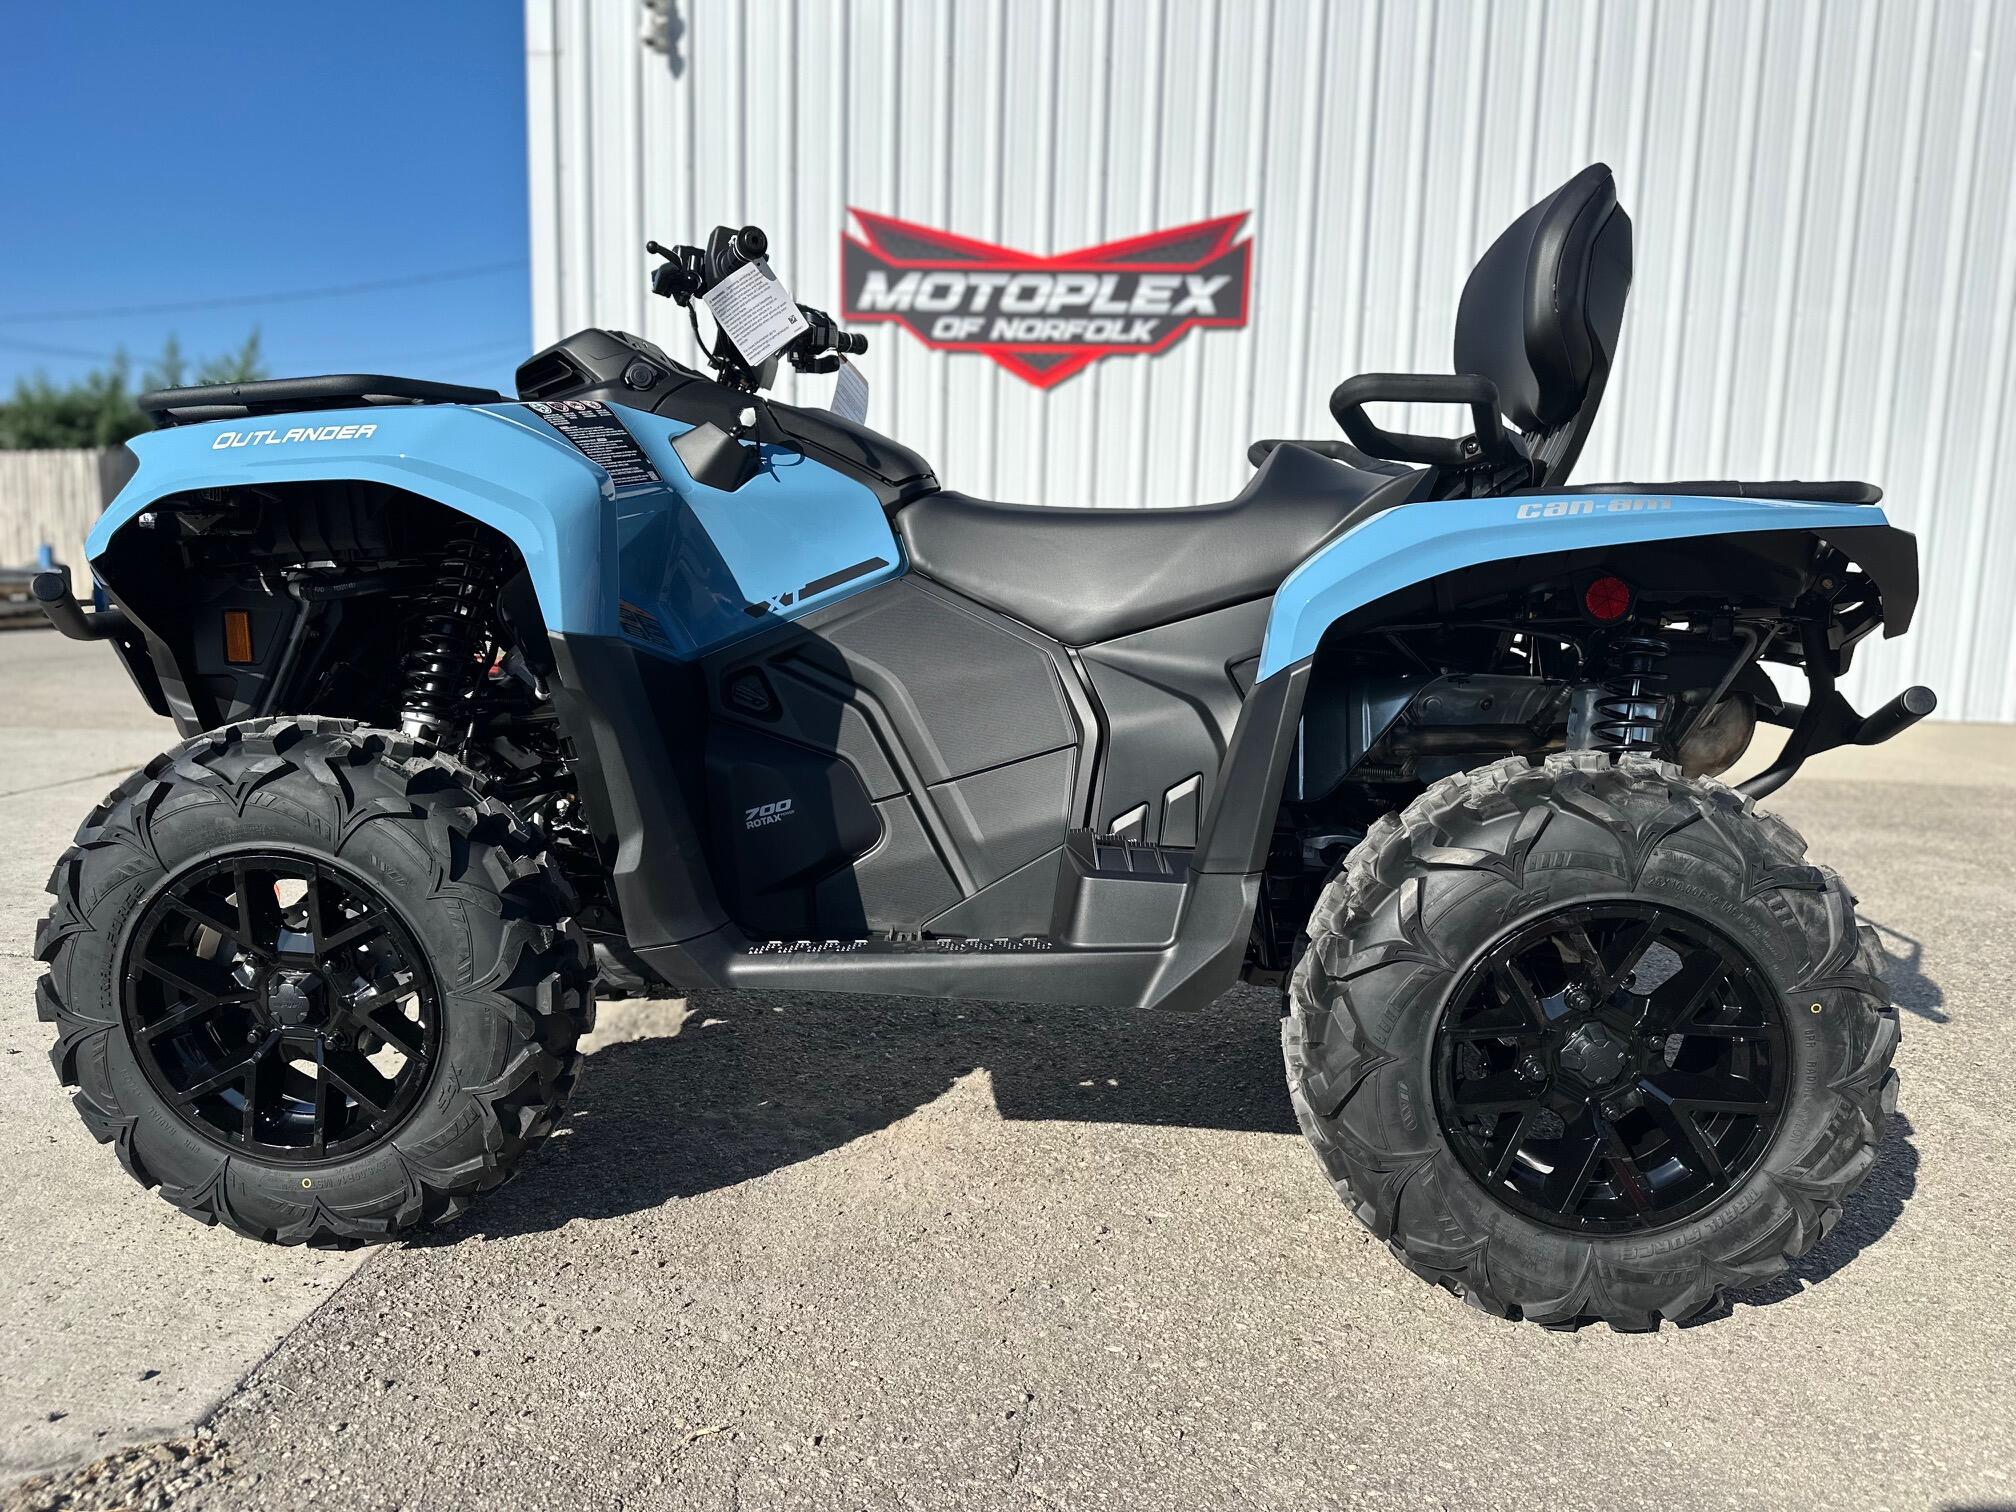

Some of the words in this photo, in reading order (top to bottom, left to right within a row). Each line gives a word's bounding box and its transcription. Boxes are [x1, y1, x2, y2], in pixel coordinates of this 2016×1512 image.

[857, 270, 1231, 315] MOTOPLEX
[931, 316, 985, 341] OF
[992, 317, 1160, 342] NORFOLK
[212, 424, 378, 450] OUTLANDER
[1516, 498, 1673, 520] can-am
[765, 584, 807, 612] XT
[745, 798, 792, 821] 700
[745, 812, 782, 830] ROTAX
